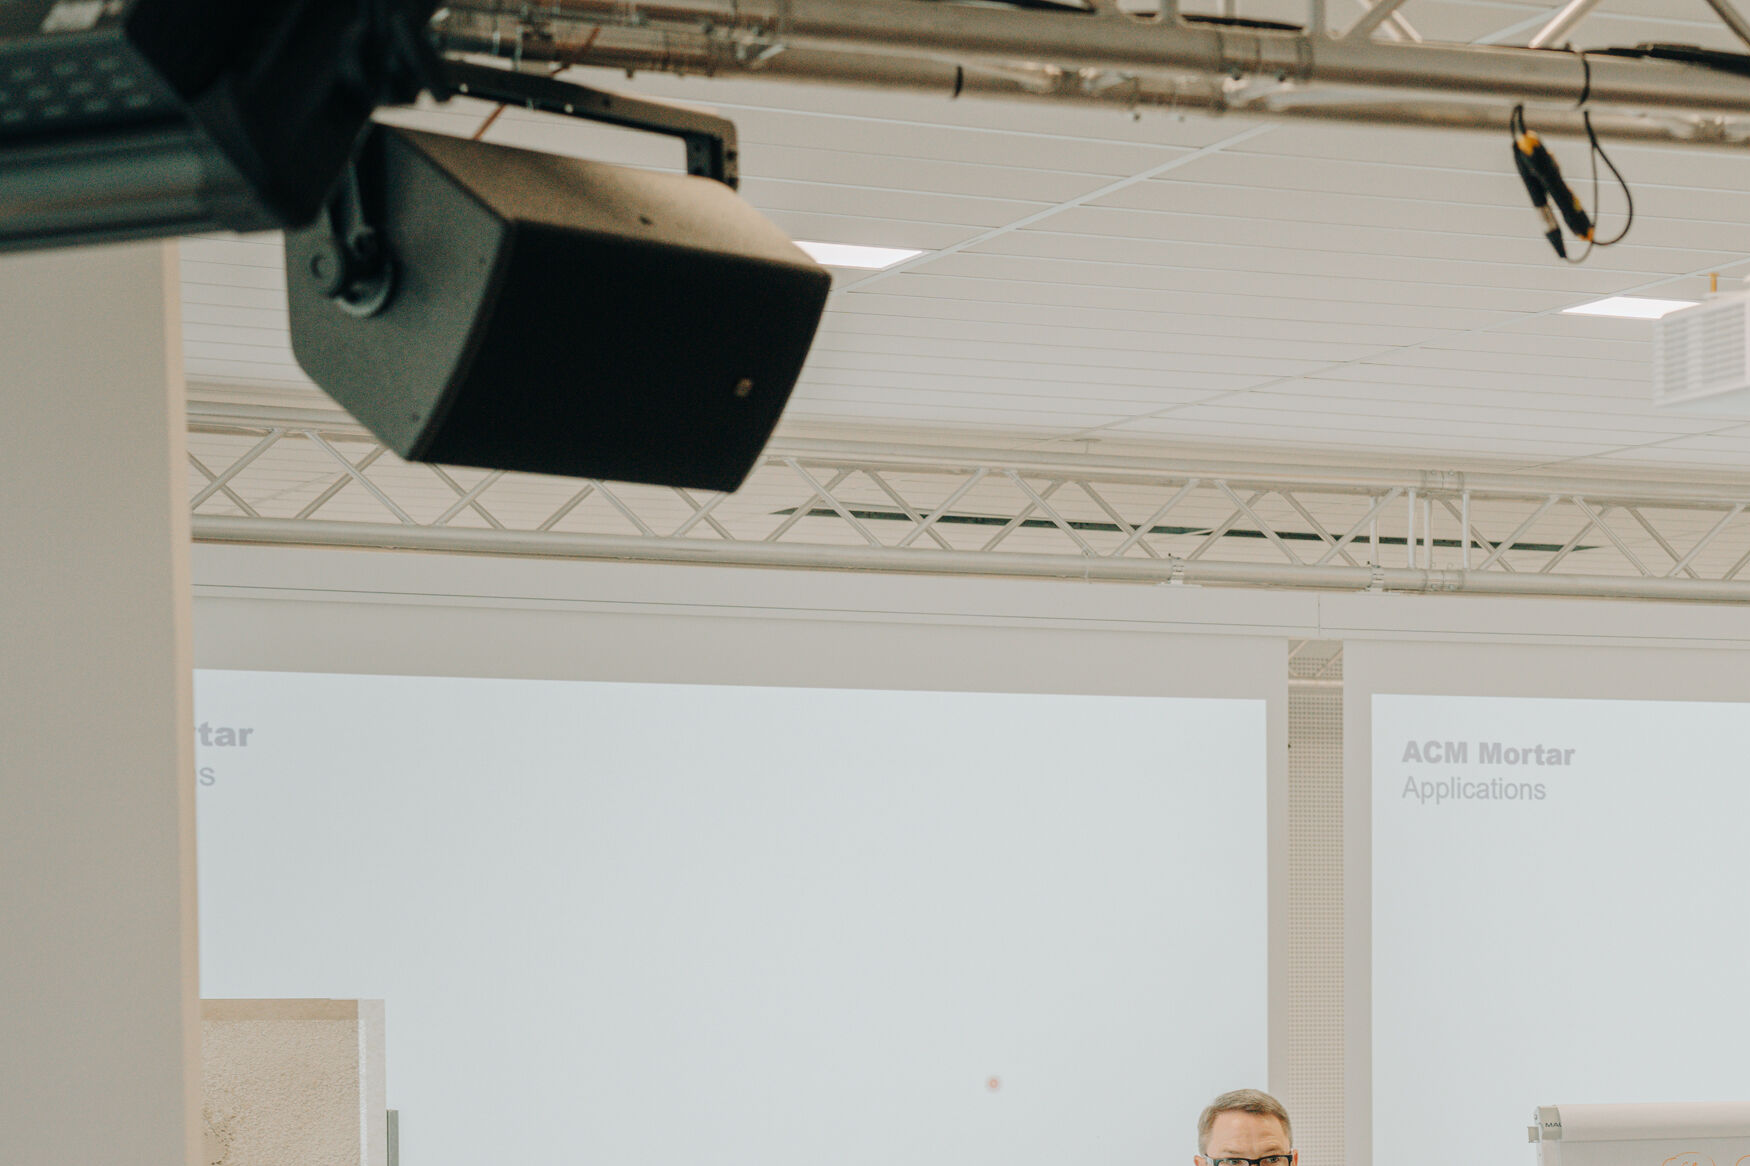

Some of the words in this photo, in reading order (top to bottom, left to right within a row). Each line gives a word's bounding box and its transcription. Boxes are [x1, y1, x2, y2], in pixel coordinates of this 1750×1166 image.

[195, 721, 254, 747] tar
[1402, 740, 1468, 764] ACM
[1478, 742, 1576, 766] Mortar
[1402, 775, 1547, 805] Applications
